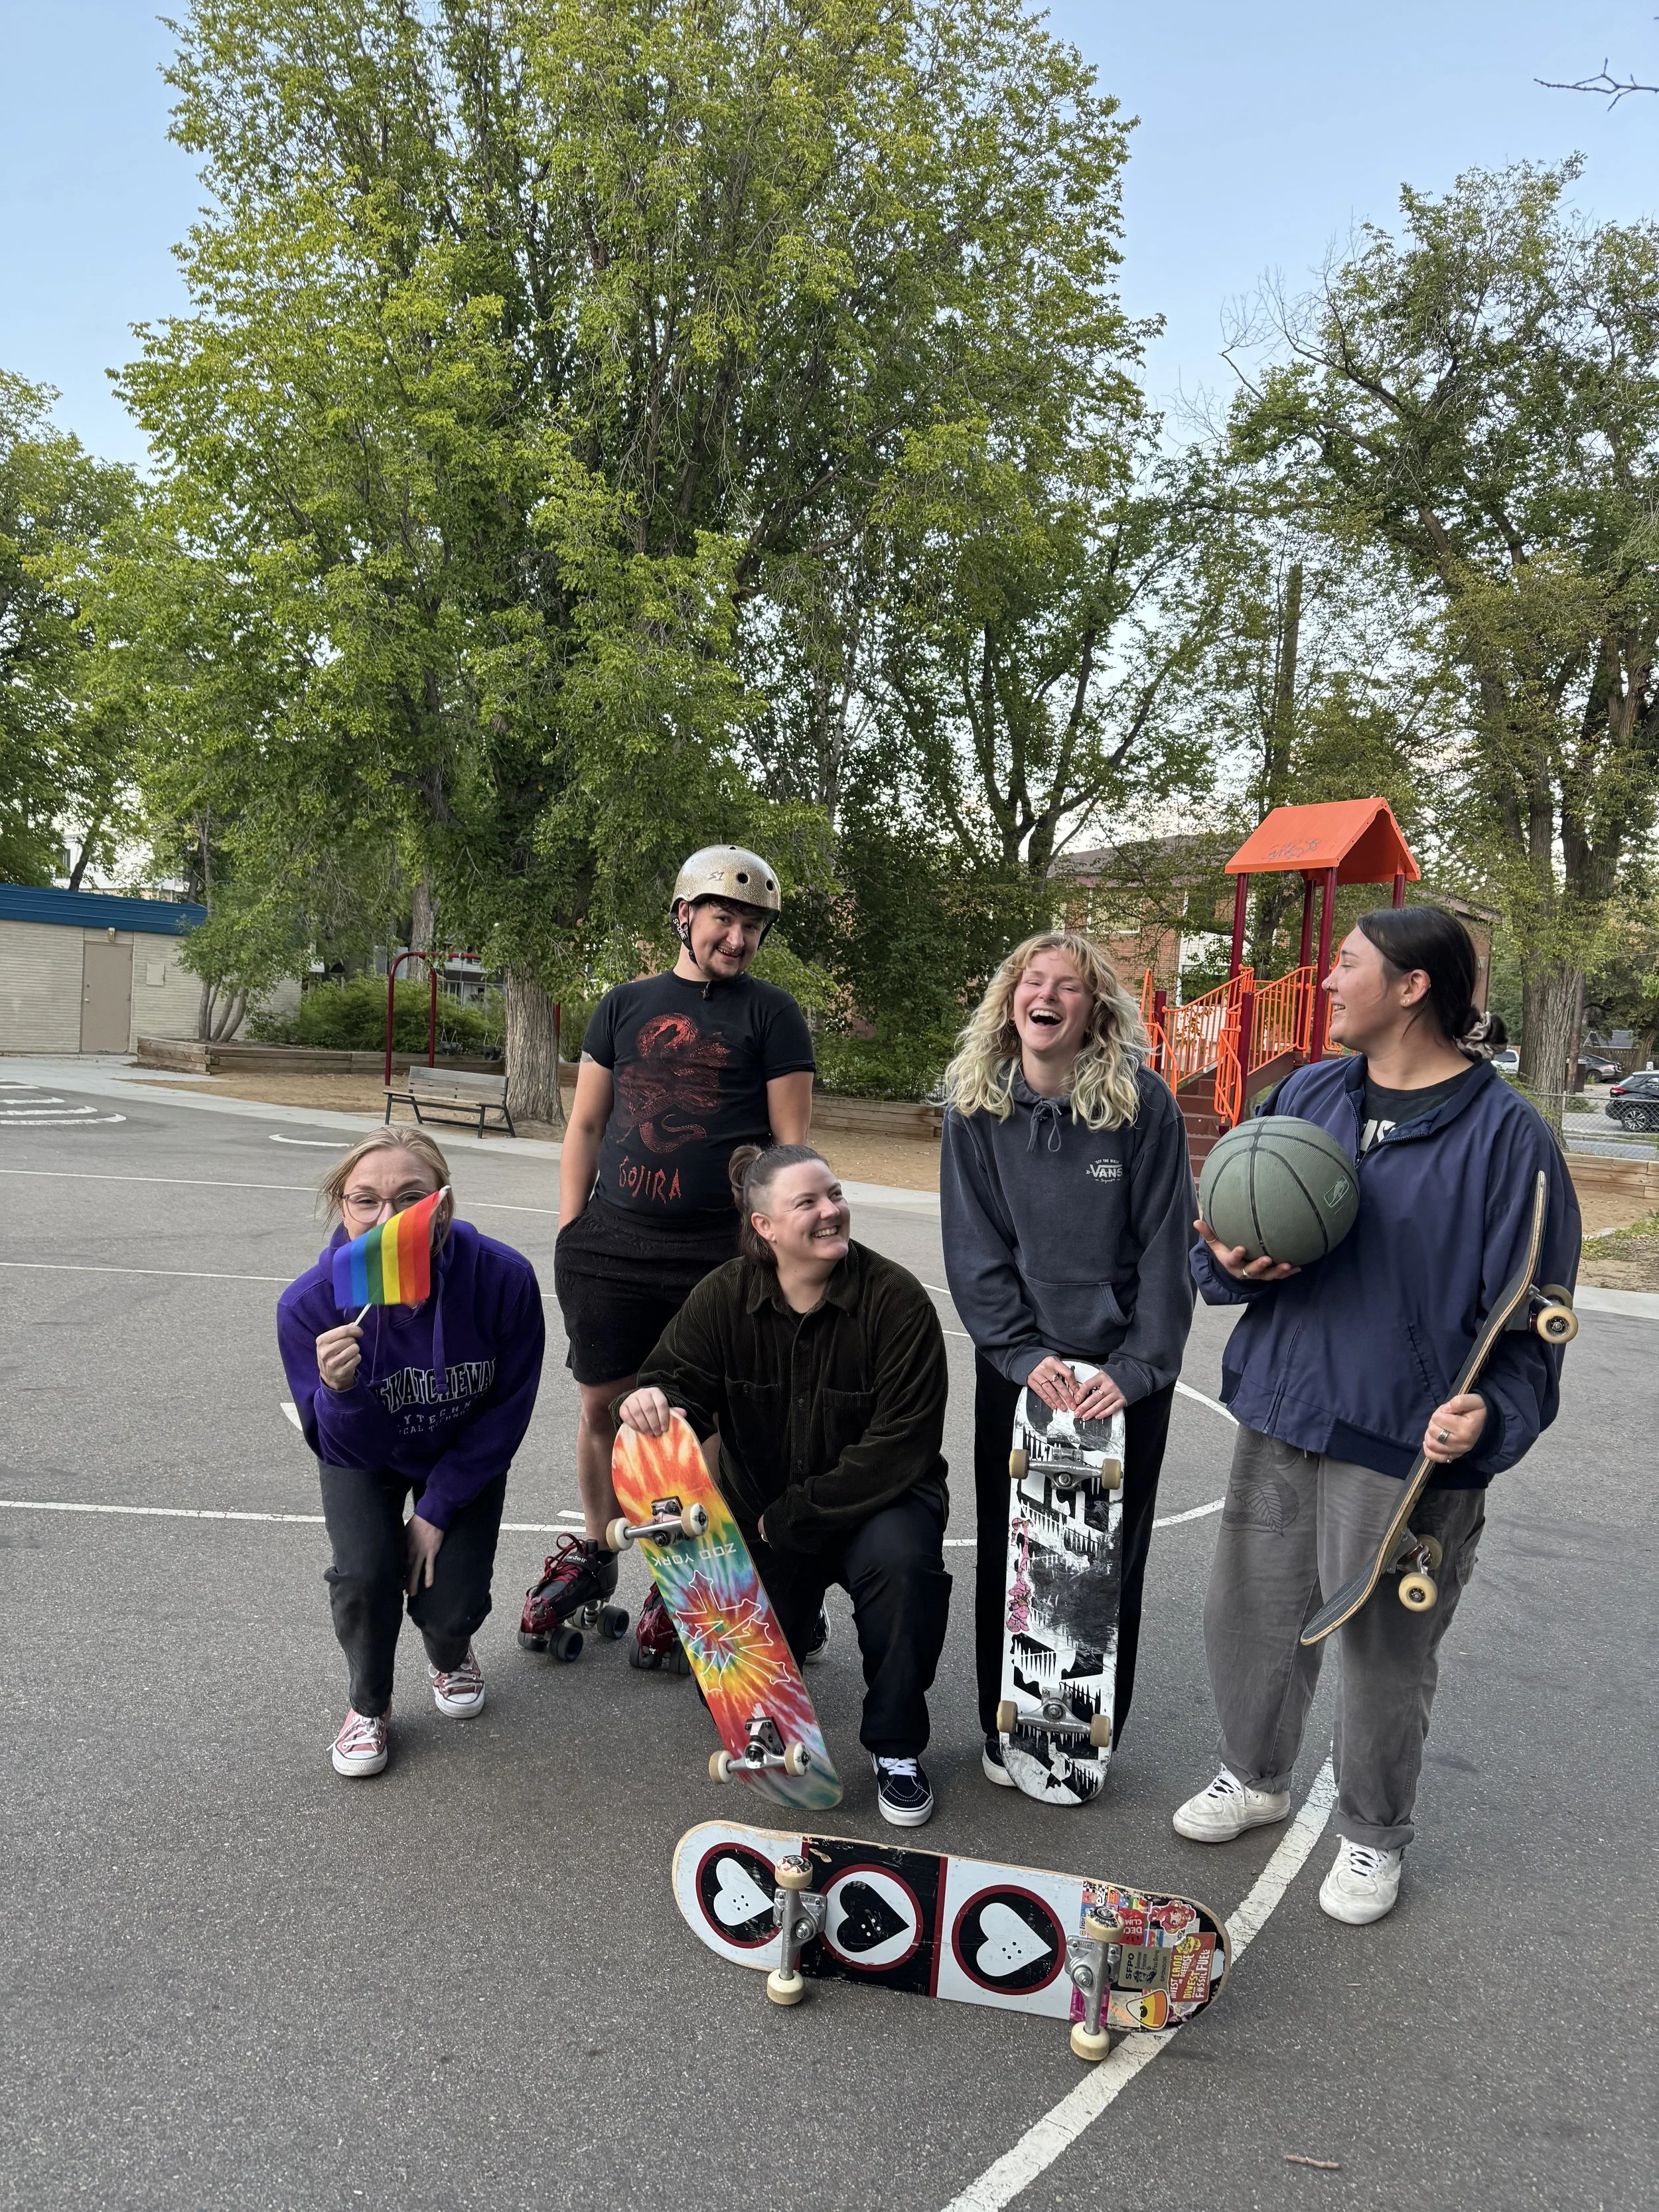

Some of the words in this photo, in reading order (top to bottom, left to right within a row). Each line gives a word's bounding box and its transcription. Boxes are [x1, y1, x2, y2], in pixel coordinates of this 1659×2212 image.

[707, 871, 724, 881] S1
[618, 1155, 682, 1205] GOJIRA
[1090, 1164, 1123, 1178] VANS
[376, 1358, 496, 1414] SKATCHEWA
[650, 1552, 694, 1567] YORK
[698, 1542, 737, 1560] ZOO
[1125, 1953, 1134, 1979] SFPO
